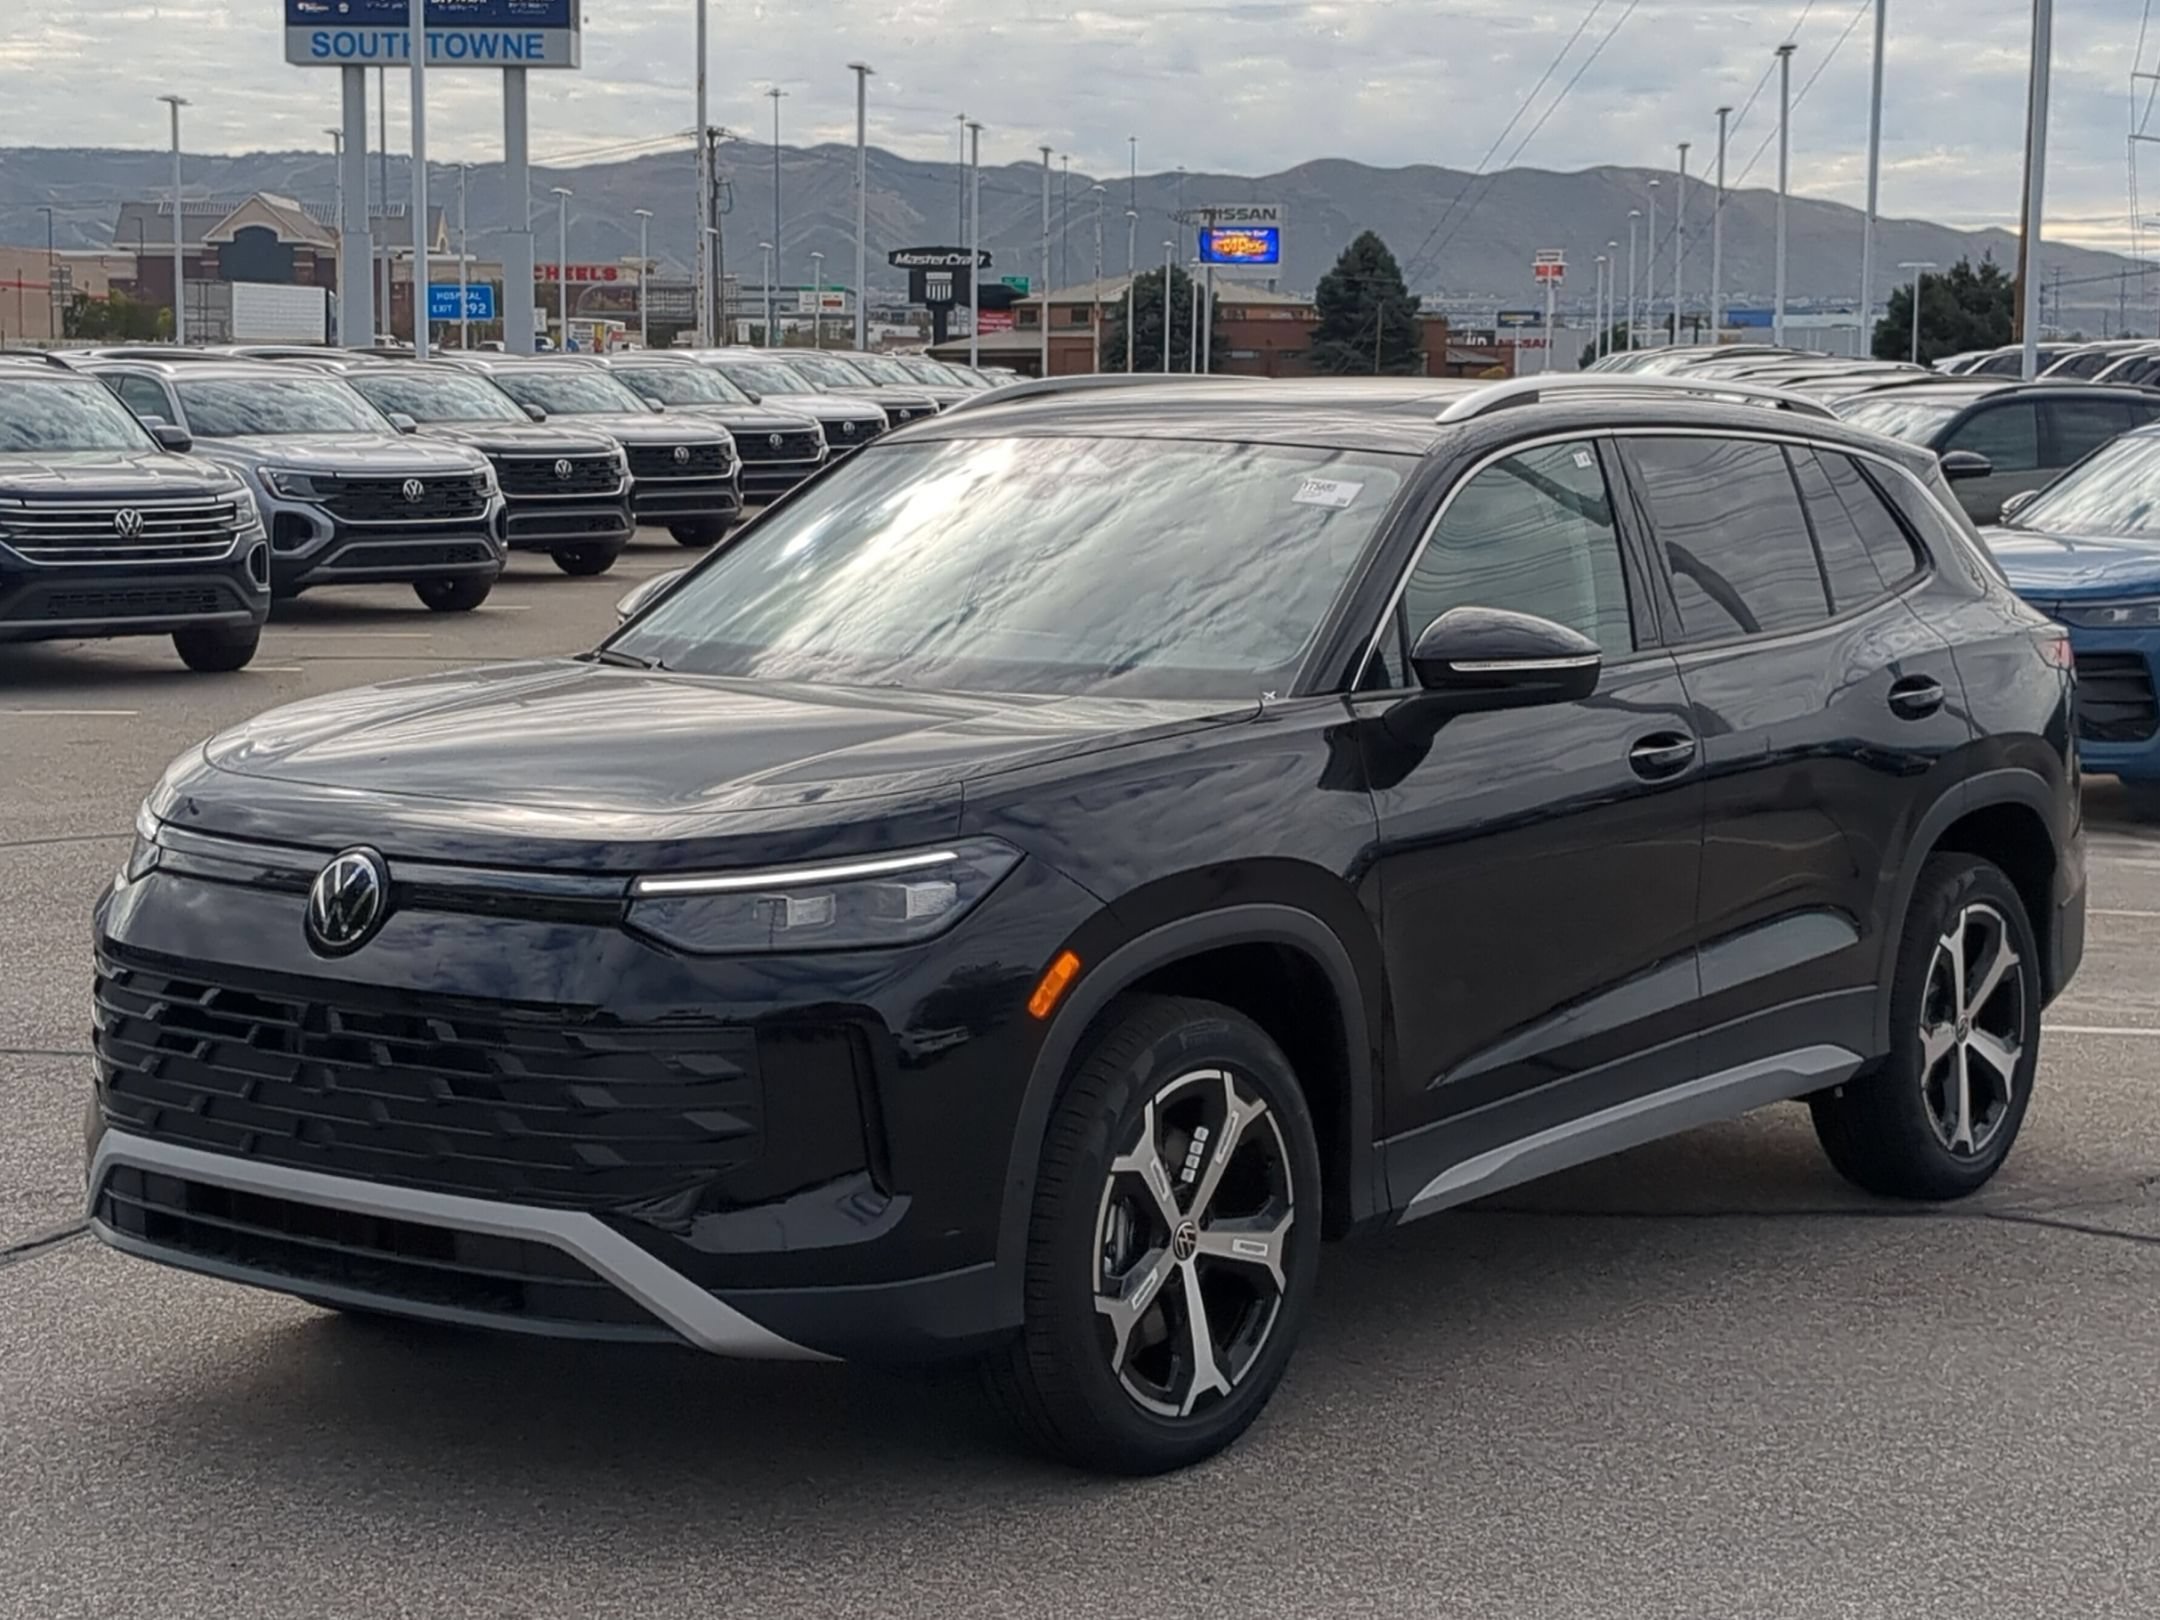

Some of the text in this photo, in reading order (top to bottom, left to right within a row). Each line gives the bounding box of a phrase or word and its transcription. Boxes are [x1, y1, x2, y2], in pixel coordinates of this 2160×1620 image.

[1202, 208, 1277, 220] NISSAN
[895, 253, 986, 266] MasterCrat
[435, 291, 482, 301] HOSPAL
